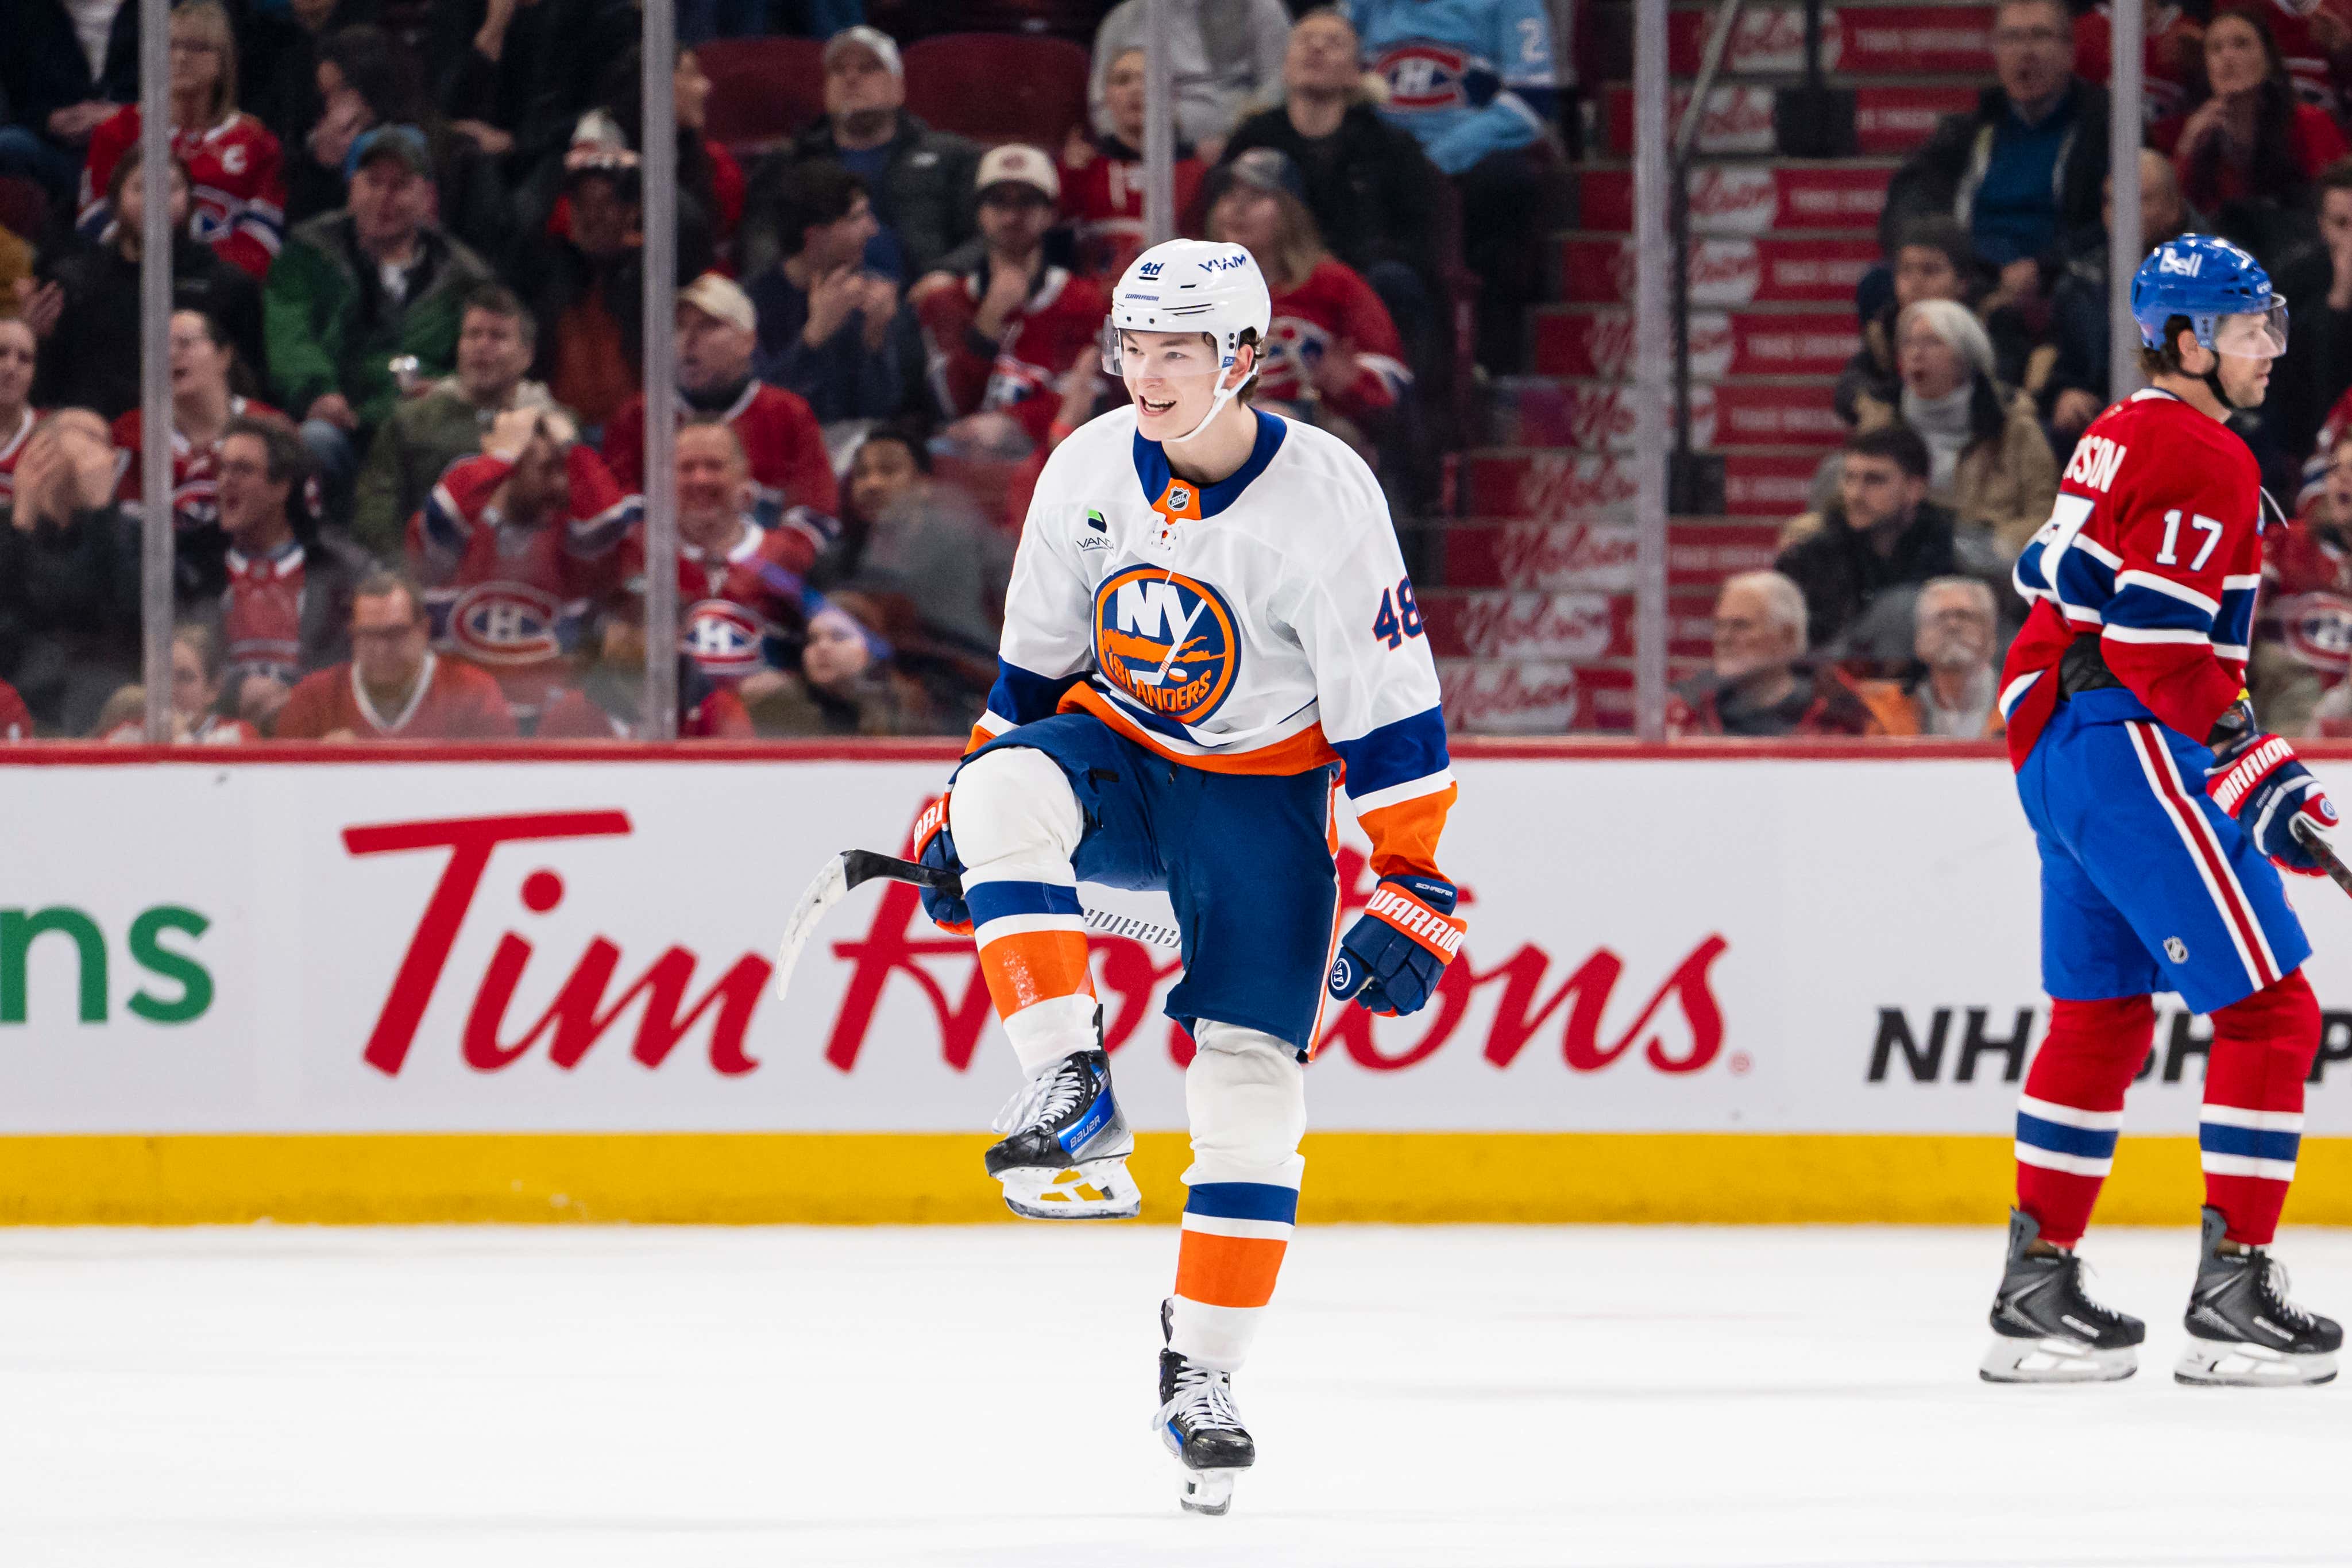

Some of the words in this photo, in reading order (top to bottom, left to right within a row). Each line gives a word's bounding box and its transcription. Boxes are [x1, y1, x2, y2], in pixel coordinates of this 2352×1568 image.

[1198, 254, 1247, 273] VIAM
[2159, 246, 2203, 279] Bell
[1125, 293, 1160, 302] WARRIOR
[2156, 508, 2224, 572] 17
[1372, 575, 1424, 652] 48
[1108, 651, 1212, 713] ISLANDERS
[340, 806, 774, 1078] Tim
